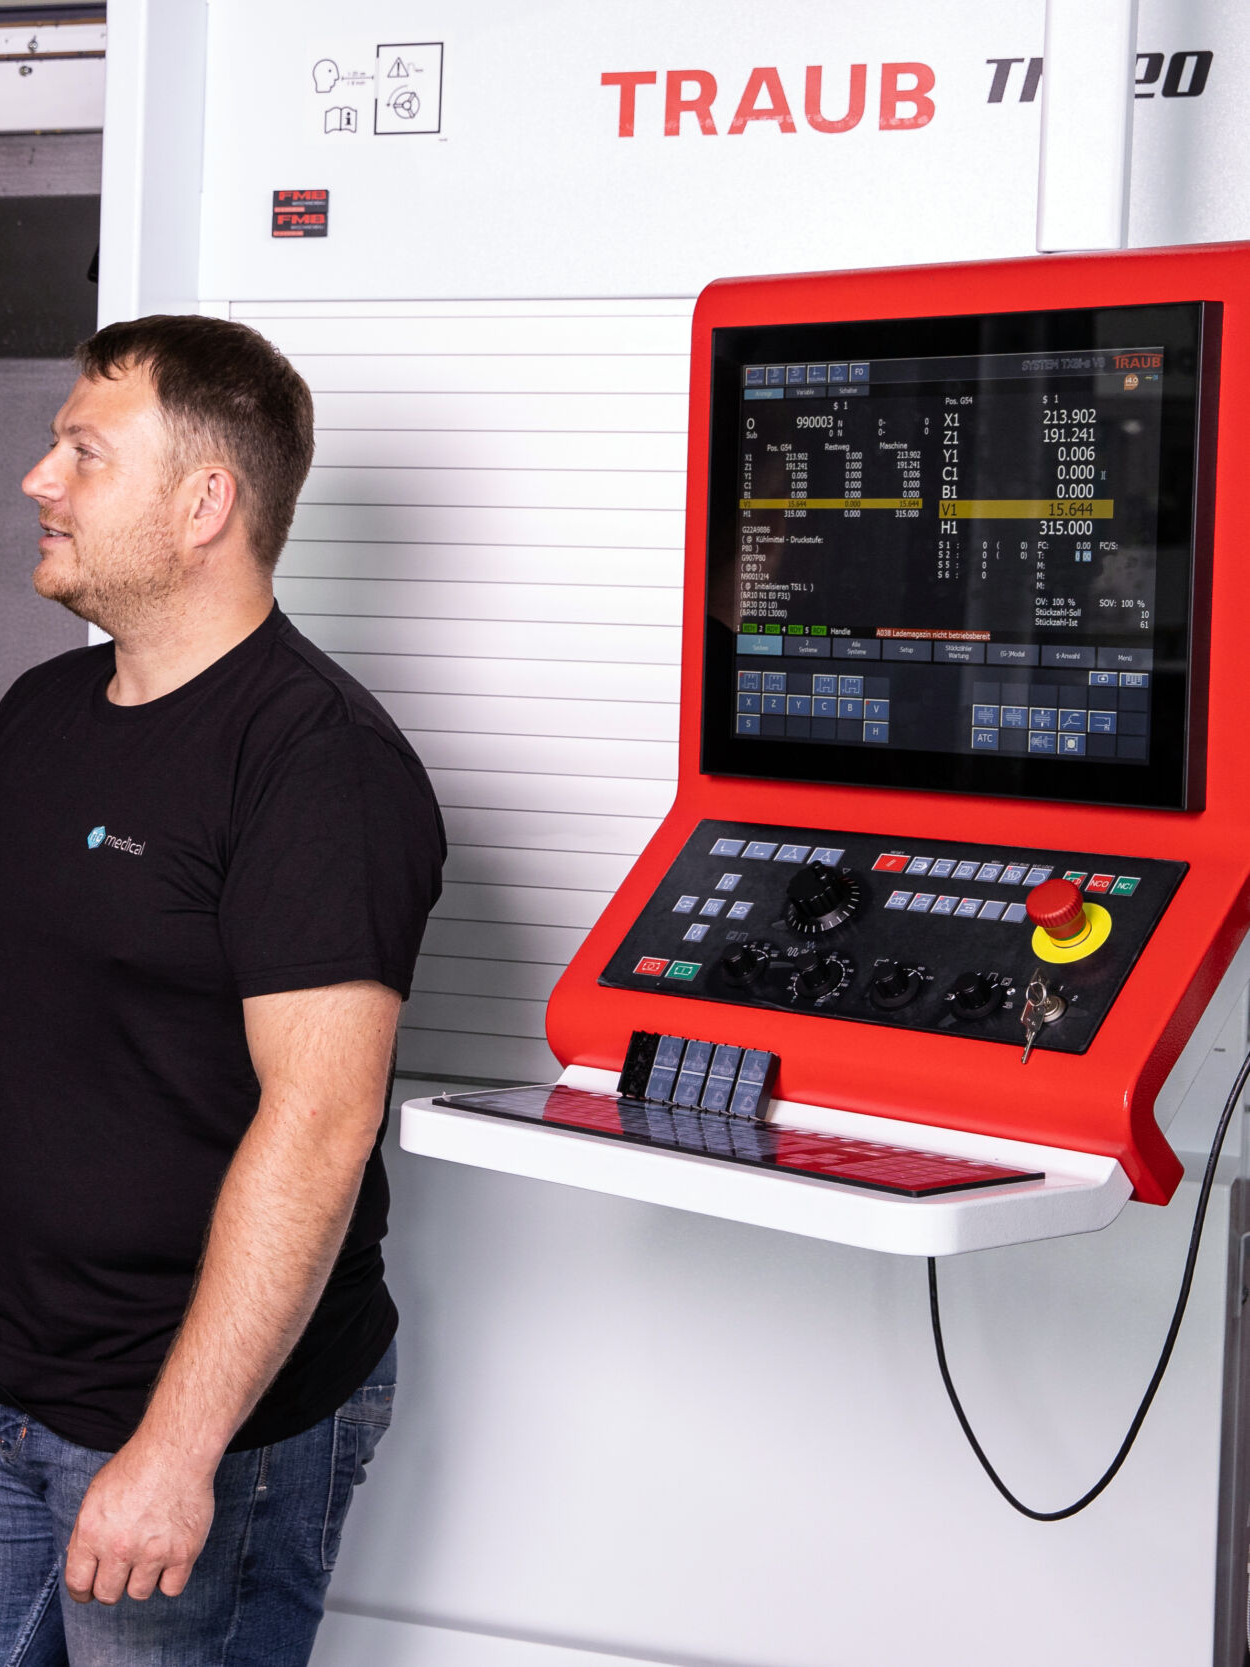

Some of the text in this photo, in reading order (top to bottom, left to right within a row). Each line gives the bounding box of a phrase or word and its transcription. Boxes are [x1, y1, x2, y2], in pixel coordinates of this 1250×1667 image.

[601, 61, 937, 139] TRAUB
[278, 190, 327, 200] FMB
[277, 214, 326, 225] FMB
[1021, 359, 1059, 371] SYSTEM
[1113, 353, 1164, 369] TRAUB
[945, 396, 973, 405] Pos. G54
[1042, 395, 1048, 404] $
[796, 415, 834, 429] 990003
[944, 409, 1097, 427] X1 213.902
[746, 431, 758, 440] Sub
[943, 428, 1096, 445] Z1 191.241
[825, 443, 850, 451] Restweg
[879, 442, 908, 450] Maschine
[786, 453, 809, 461] 213.902
[846, 452, 863, 460] 0.000
[896, 451, 921, 459] 213.902
[943, 447, 1096, 463] Y1 0.006
[786, 462, 808, 470] 191.241
[845, 462, 862, 470] 0.000
[897, 461, 921, 469] 191.241
[791, 472, 808, 480] 0.006
[845, 471, 862, 479] 0.000
[903, 471, 921, 479] 0.006
[942, 465, 1095, 481] C1 0.000
[791, 481, 808, 490] 0.000
[845, 481, 862, 489] 0.000
[903, 481, 920, 489] 0.000
[791, 491, 808, 499] 0.000
[844, 491, 862, 499] 0.000
[902, 490, 920, 498] 0.000
[942, 484, 1094, 499] B1 0.000
[942, 502, 1094, 516] V1 15.644
[784, 510, 807, 518] 315.000
[844, 510, 861, 518] 0.000
[895, 510, 919, 518] 315.000
[941, 521, 1093, 535] H1 315.000
[790, 536, 824, 544] Druckstufe:
[1037, 542, 1049, 550] FC:
[1076, 542, 1092, 550] 0.00
[1099, 542, 1118, 550] FC/S:
[1035, 598, 1048, 606] OV:
[1052, 598, 1065, 606] 100
[1099, 599, 1145, 608] SOV: 100 %
[1035, 608, 1150, 619] Stückzahl-Soll 10
[1035, 618, 1149, 629] Stückzahl-Ist 61
[830, 627, 851, 636] Handle
[892, 630, 932, 640] Lademagazin
[932, 631, 947, 639] nicht
[948, 632, 991, 641] betriebsbereit
[948, 652, 970, 660] Wartung
[1118, 654, 1133, 662] Menü
[822, 703, 827, 711] C
[847, 704, 853, 712] B
[873, 728, 879, 736] H
[977, 734, 993, 743] ATC
[104, 834, 146, 856] medical
